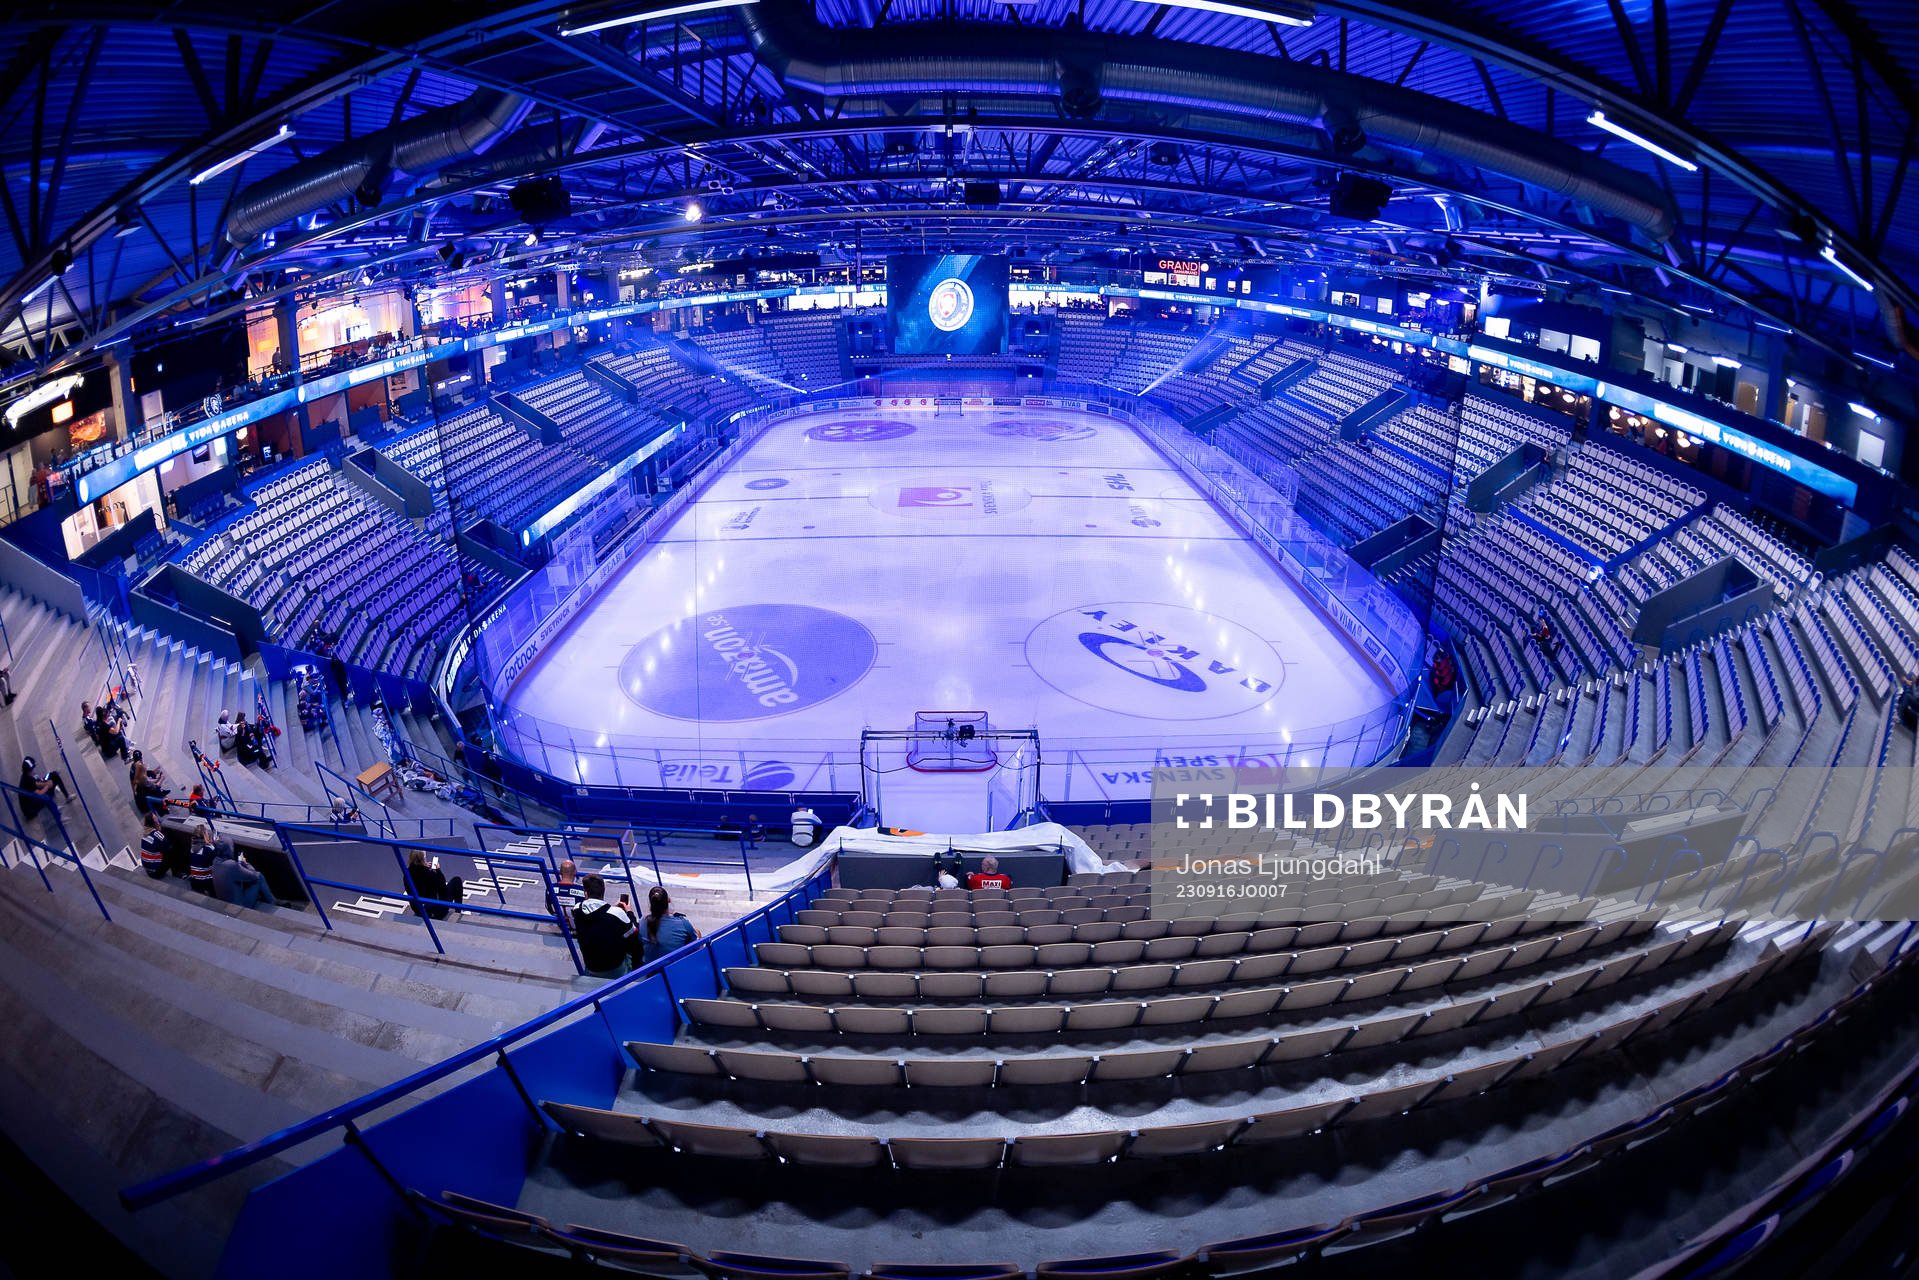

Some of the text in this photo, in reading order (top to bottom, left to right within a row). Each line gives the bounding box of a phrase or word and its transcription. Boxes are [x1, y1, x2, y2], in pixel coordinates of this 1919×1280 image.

[1158, 260, 1198, 270] GRAND
[188, 426, 213, 442] VIDA
[467, 604, 507, 644] VDA ARENA
[504, 640, 538, 687] Fortnox
[1162, 754, 1220, 768] SPEL
[663, 764, 733, 783] Telia
[1102, 767, 1226, 784] SVENSKA
